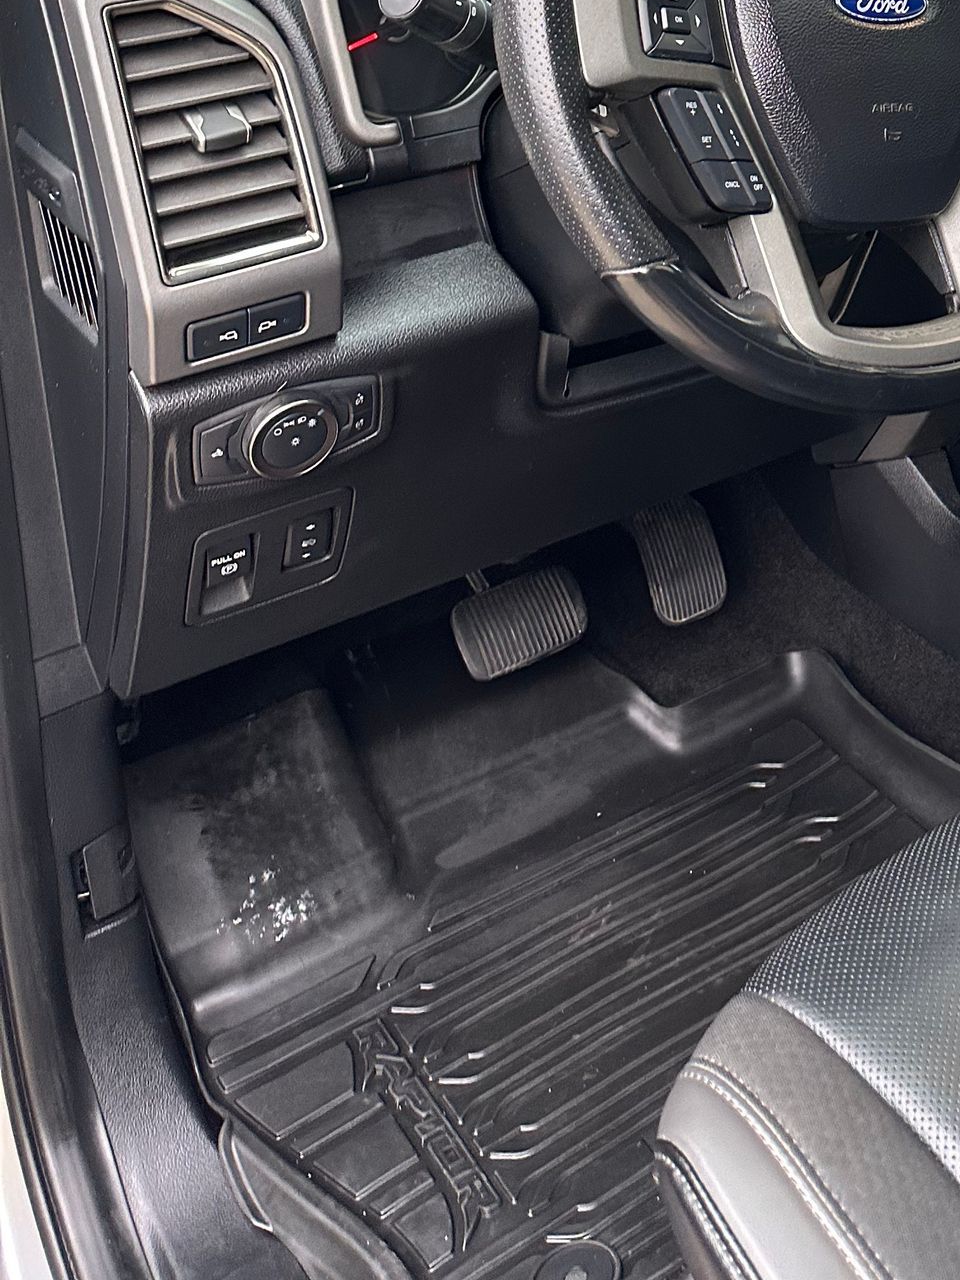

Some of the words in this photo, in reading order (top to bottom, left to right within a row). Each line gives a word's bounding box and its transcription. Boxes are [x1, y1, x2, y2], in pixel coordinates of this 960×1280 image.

[674, 15, 684, 24] OK
[685, 101, 698, 109] RES
[871, 103, 913, 114] AIRBAG
[701, 135, 713, 144] SET
[750, 175, 759, 183] ON
[725, 180, 740, 189] CNCL
[753, 183, 763, 191] OFF
[211, 555, 232, 567] PULL
[233, 549, 246, 560] ON
